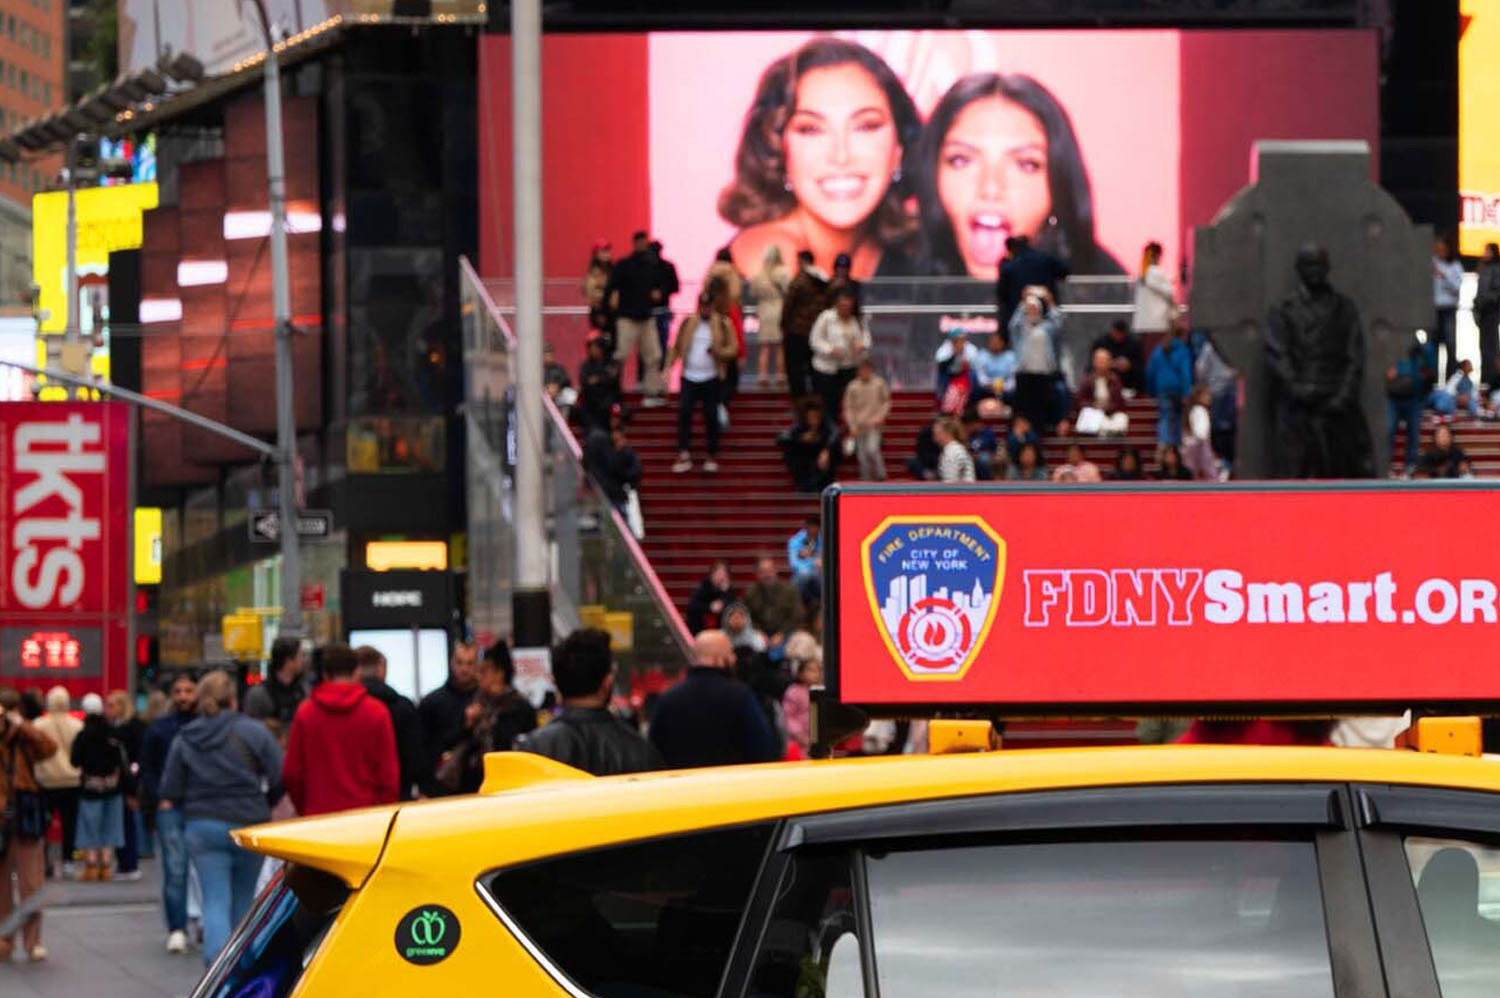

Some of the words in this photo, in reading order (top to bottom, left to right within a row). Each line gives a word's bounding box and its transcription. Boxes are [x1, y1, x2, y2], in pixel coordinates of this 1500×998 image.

[12, 413, 107, 609] tkts
[878, 537, 904, 565] FIRE
[908, 527, 991, 562] DEPARTMENT
[910, 549, 938, 560] CITY
[943, 549, 960, 560] OF
[902, 560, 928, 571] NEW
[935, 560, 968, 571] YORK
